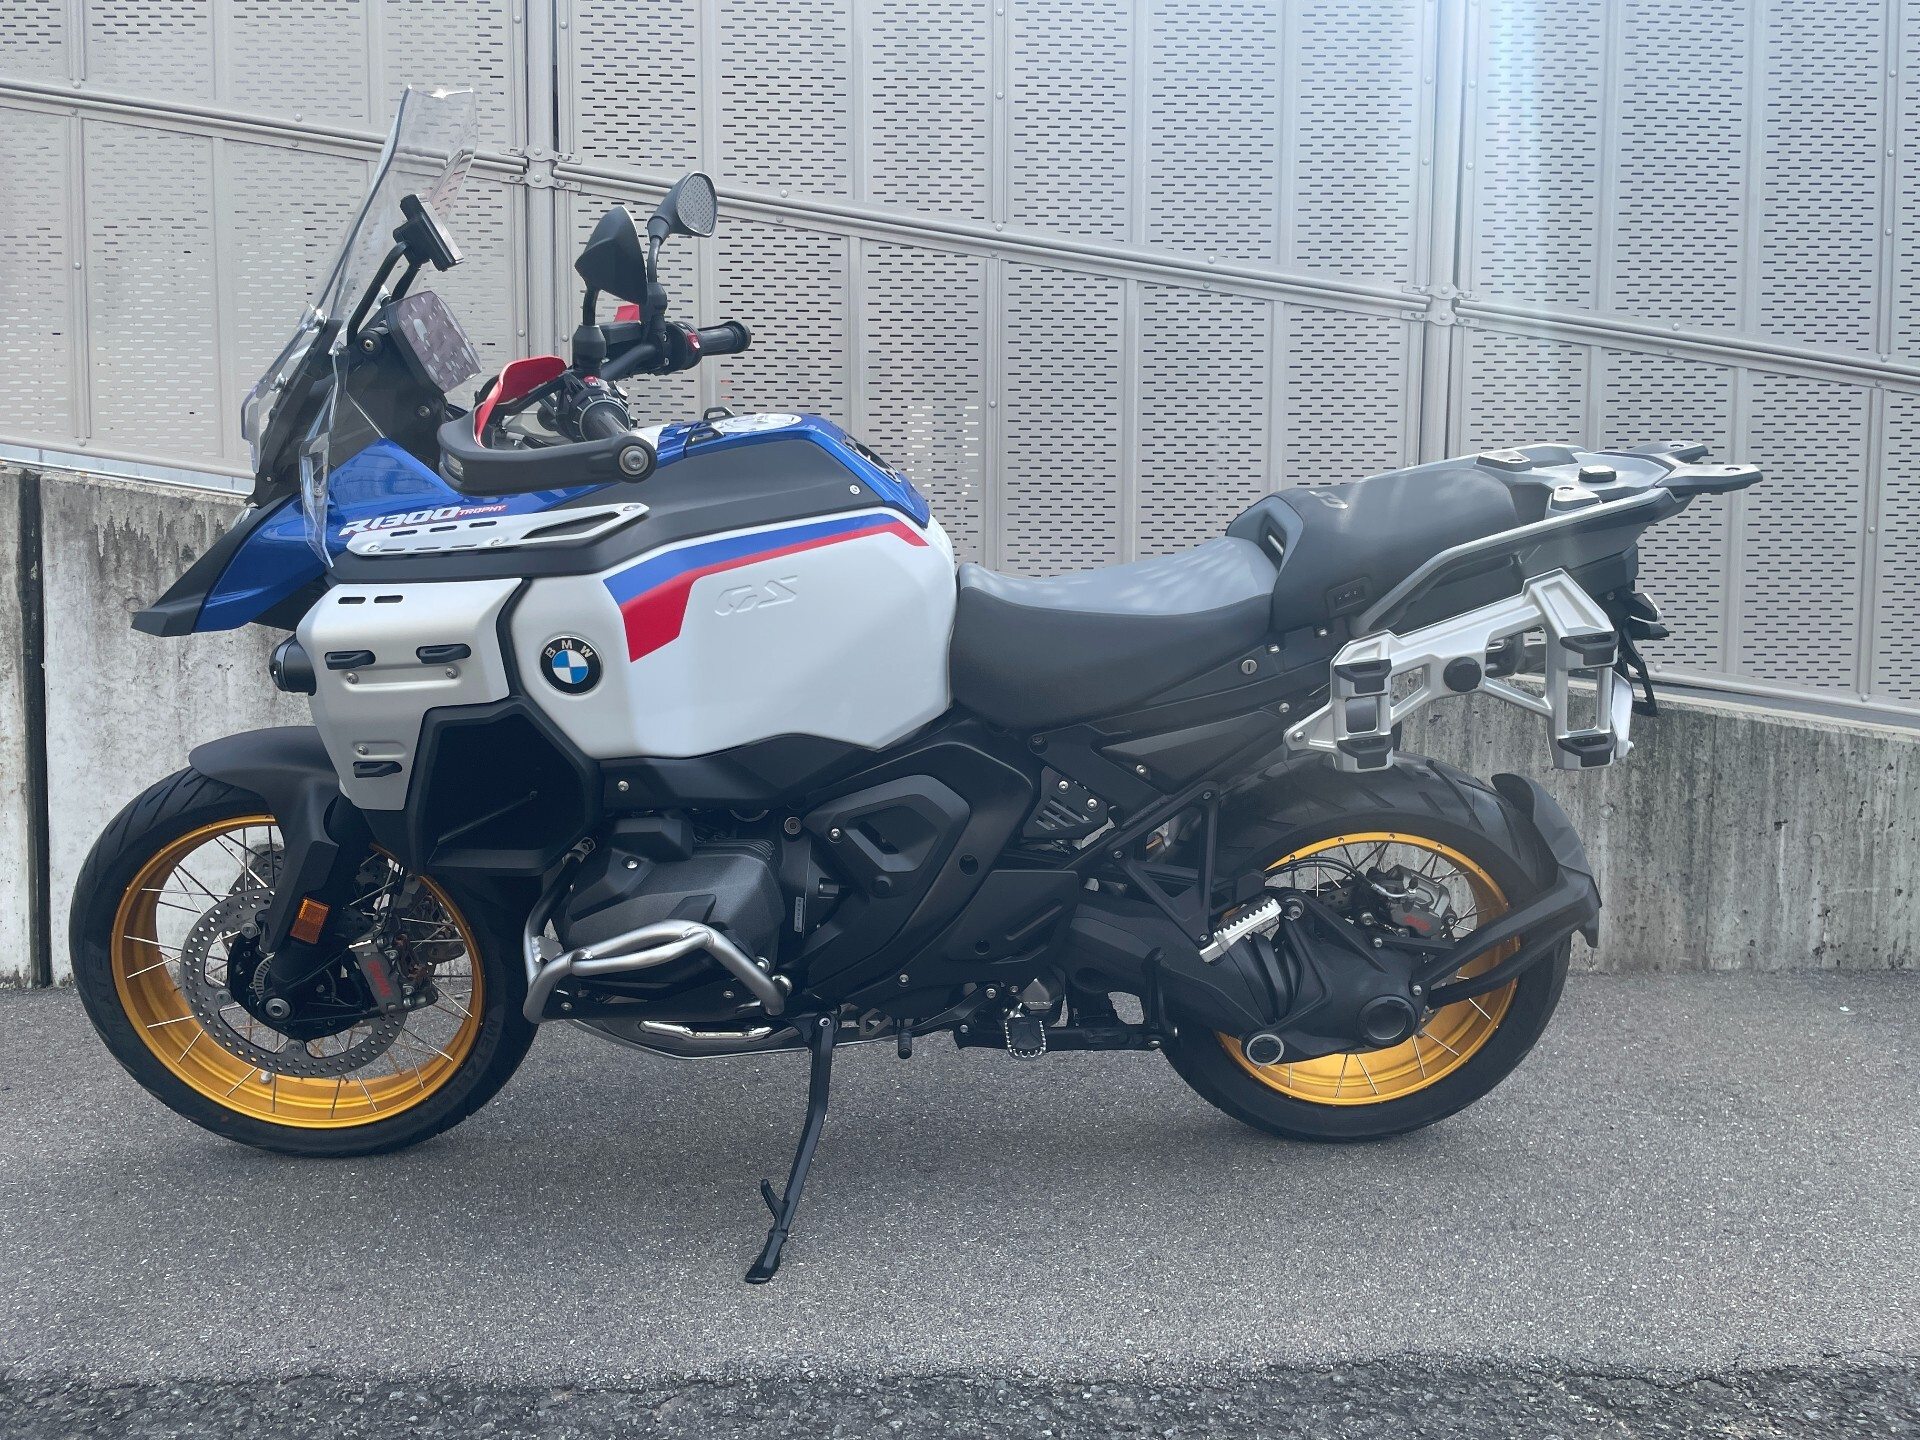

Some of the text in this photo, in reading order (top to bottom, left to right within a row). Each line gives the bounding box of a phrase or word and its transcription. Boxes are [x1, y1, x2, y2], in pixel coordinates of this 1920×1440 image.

[339, 504, 508, 537] R1300 TROPHY
[544, 639, 594, 659] BMW
